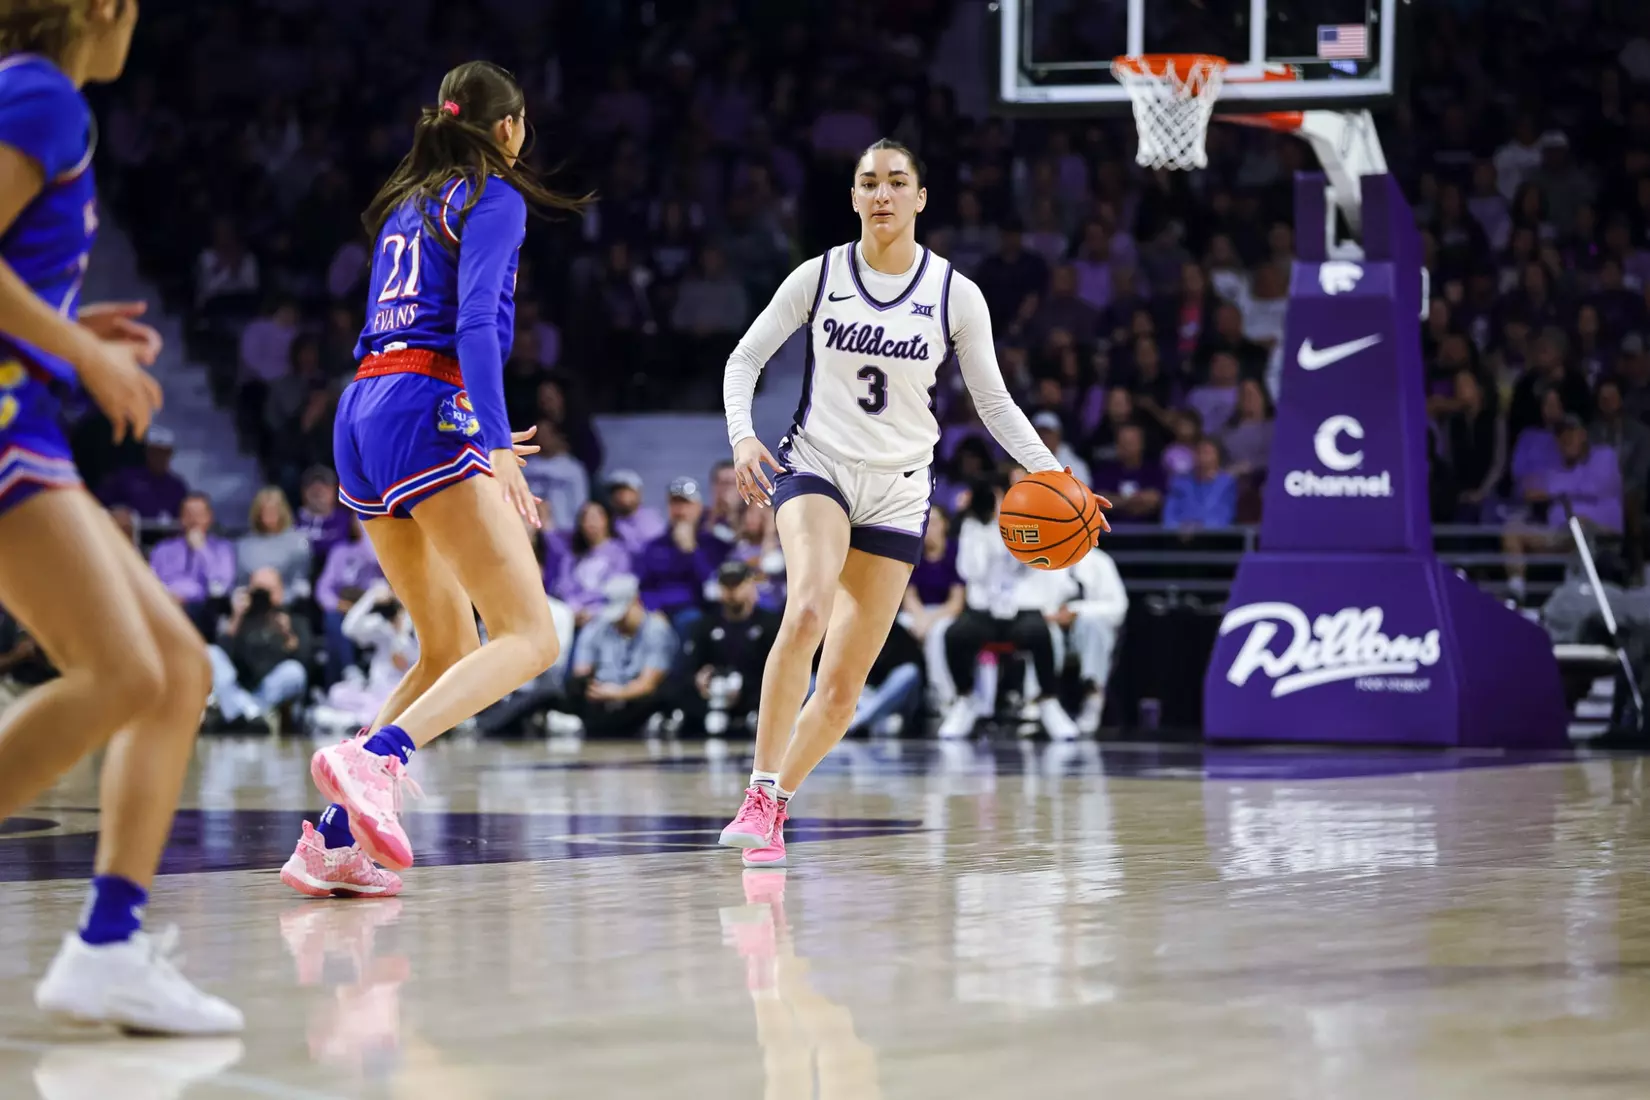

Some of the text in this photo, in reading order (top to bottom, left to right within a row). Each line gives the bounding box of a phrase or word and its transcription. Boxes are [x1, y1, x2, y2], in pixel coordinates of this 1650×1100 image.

[378, 229, 421, 303] 21
[374, 303, 418, 333] EVANS
[911, 302, 936, 317] XII
[823, 318, 929, 360] Wildcats
[857, 365, 888, 415] 3
[453, 410, 467, 422] KU
[1284, 470, 1390, 497] Channel
[1000, 526, 1040, 544] ELITE
[1219, 602, 1440, 690] Dillons
